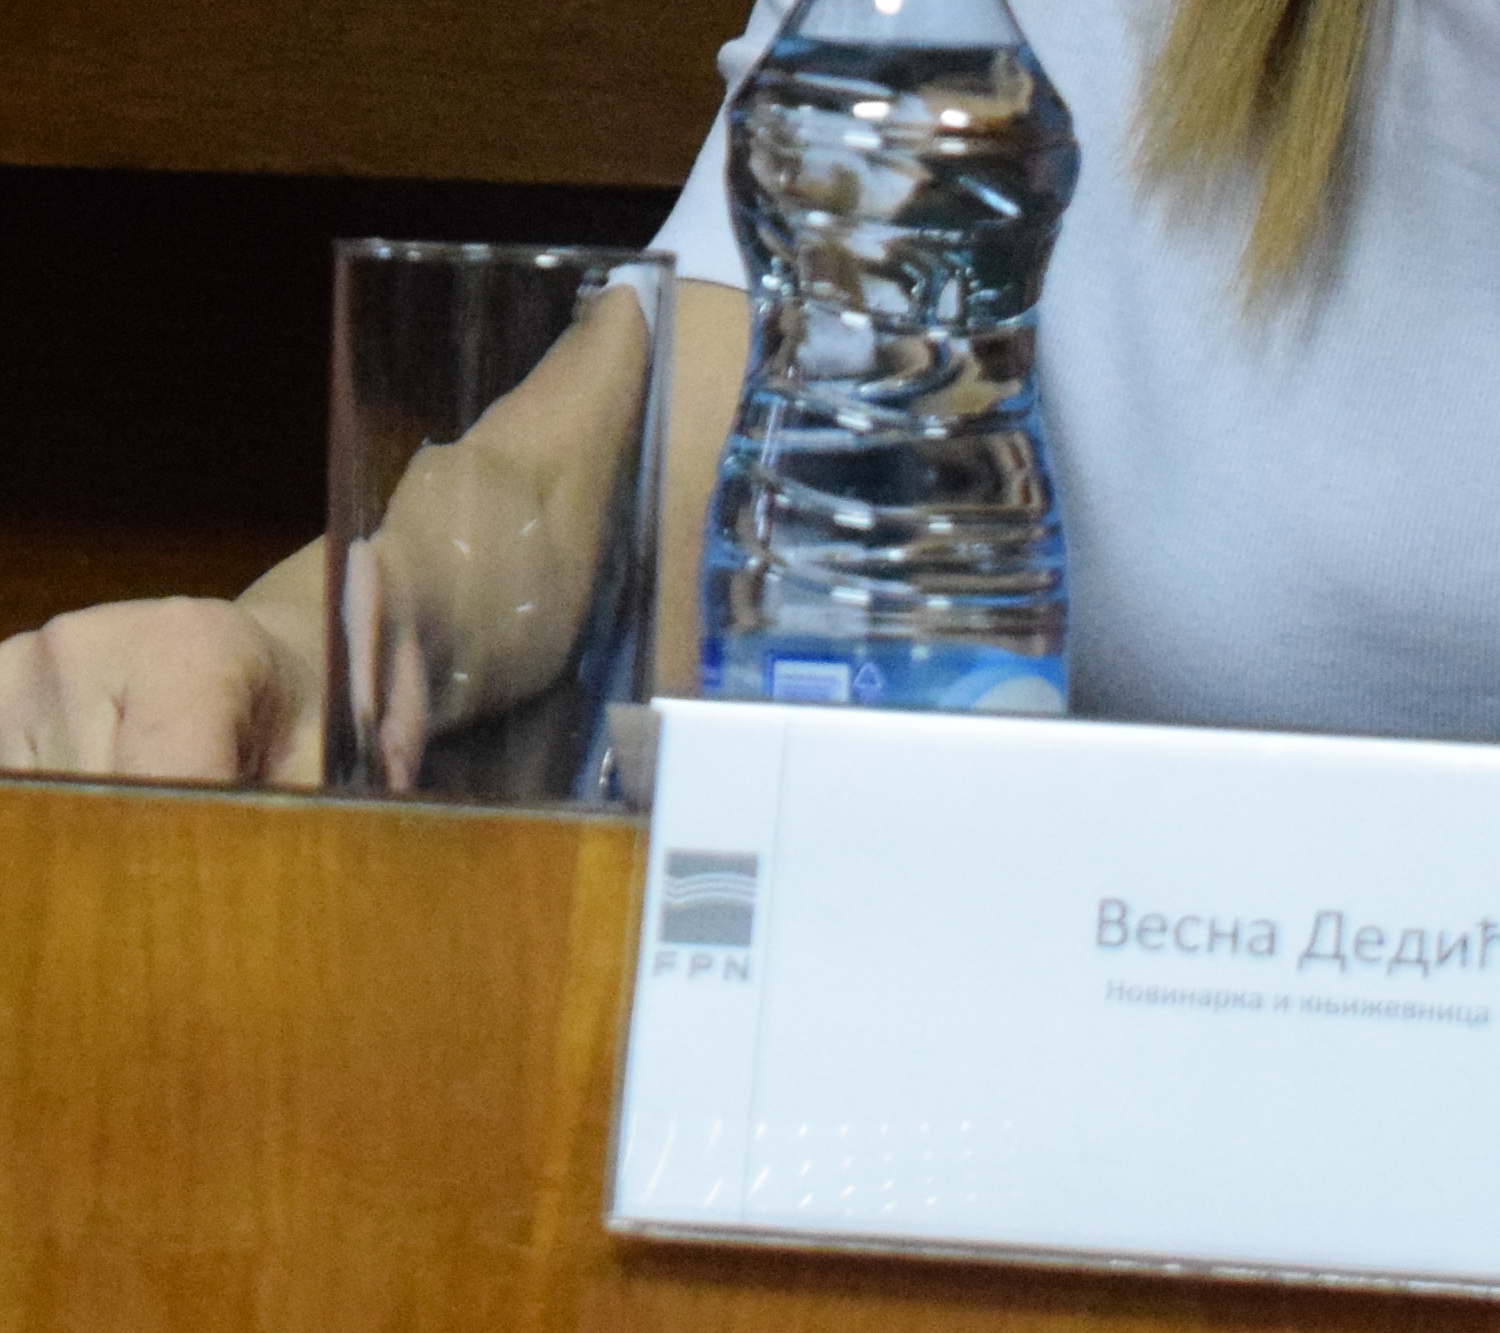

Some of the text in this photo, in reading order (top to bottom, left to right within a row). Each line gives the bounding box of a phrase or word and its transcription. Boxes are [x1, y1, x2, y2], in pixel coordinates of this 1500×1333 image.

[1095, 896, 1278, 959] Весна
[652, 950, 750, 981] FPN
[1106, 978, 1264, 1014] Новинарка
[1272, 994, 1290, 1013] и
